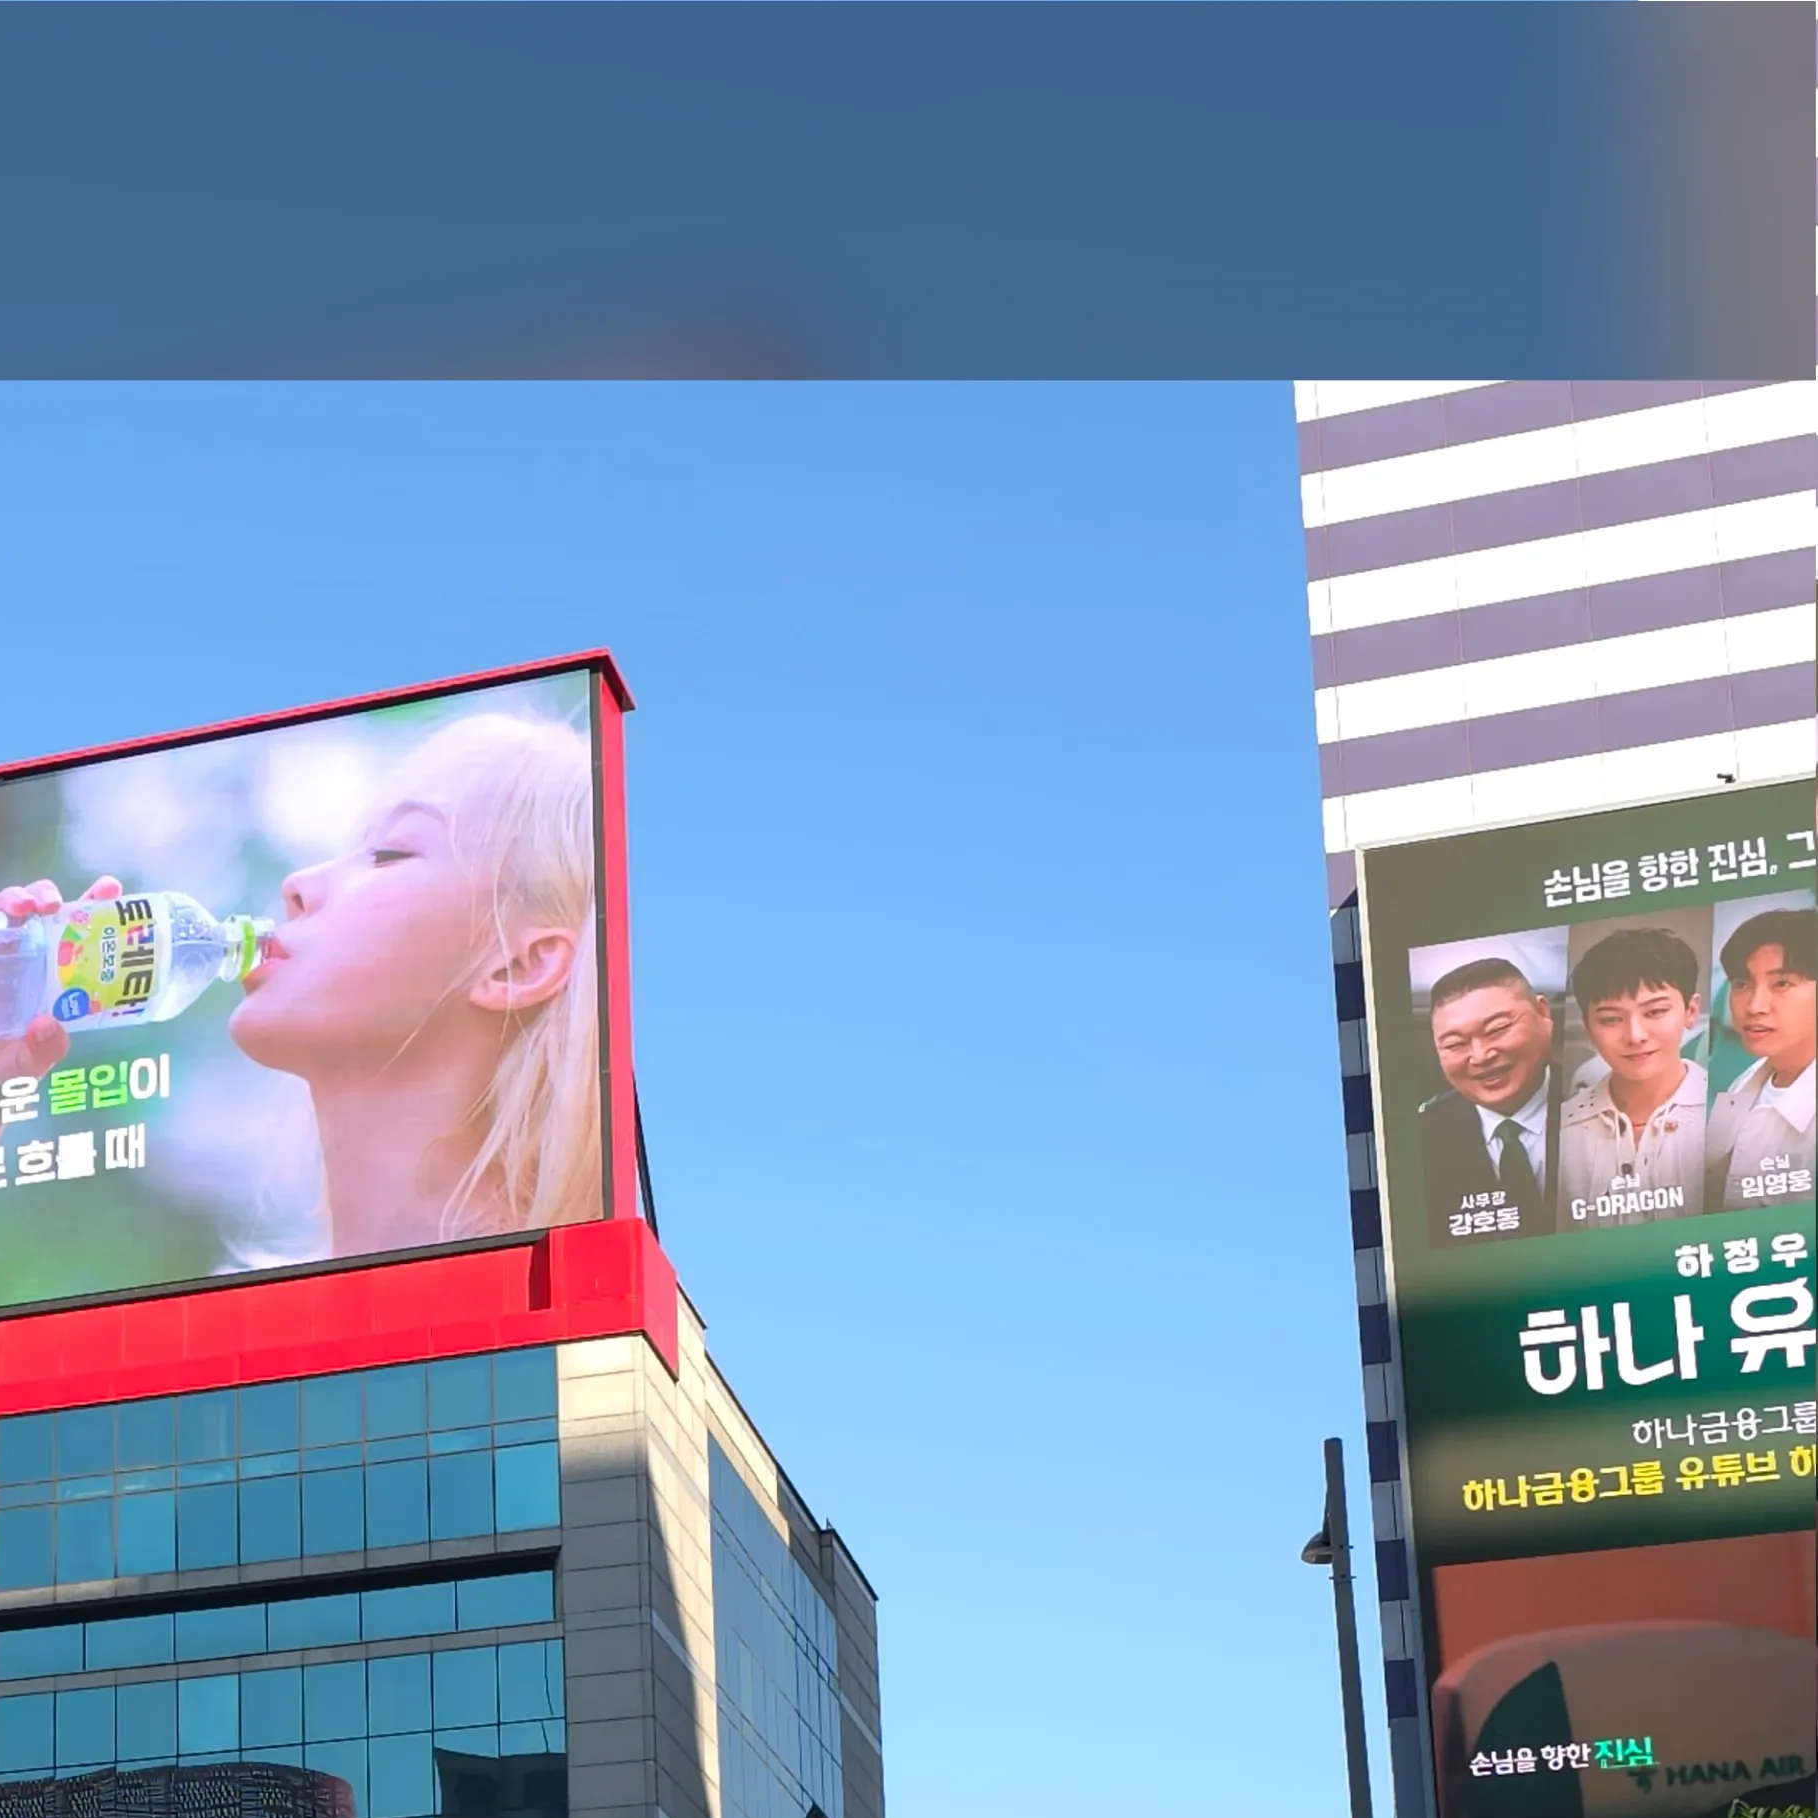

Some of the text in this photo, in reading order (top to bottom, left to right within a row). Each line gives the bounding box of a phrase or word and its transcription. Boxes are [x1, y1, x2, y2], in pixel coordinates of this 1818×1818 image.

[1544, 859, 1631, 908] 손님을
[1638, 847, 1699, 893] 향한
[49, 1053, 170, 1115] 몰입이
[15, 1131, 97, 1186] 흐를
[105, 1123, 146, 1170] 때
[1759, 1153, 1790, 1172] 손님
[1611, 1172, 1641, 1191] 손님
[1741, 1171, 1812, 1200] 임영웅
[1460, 1190, 1507, 1211] 사무장
[1571, 1187, 1684, 1220] G-DRAGON
[1449, 1207, 1521, 1236] 강호동
[1518, 1276, 1816, 1395] 하나 유
[1632, 1401, 1816, 1449] 하나금융그룹
[1462, 1461, 1664, 1512] 하나금융그룹
[1675, 1450, 1780, 1491] 유튜브
[1469, 1736, 1656, 1777] 손님을 향한 진심
[1666, 1755, 1805, 1788] HANA AIR
